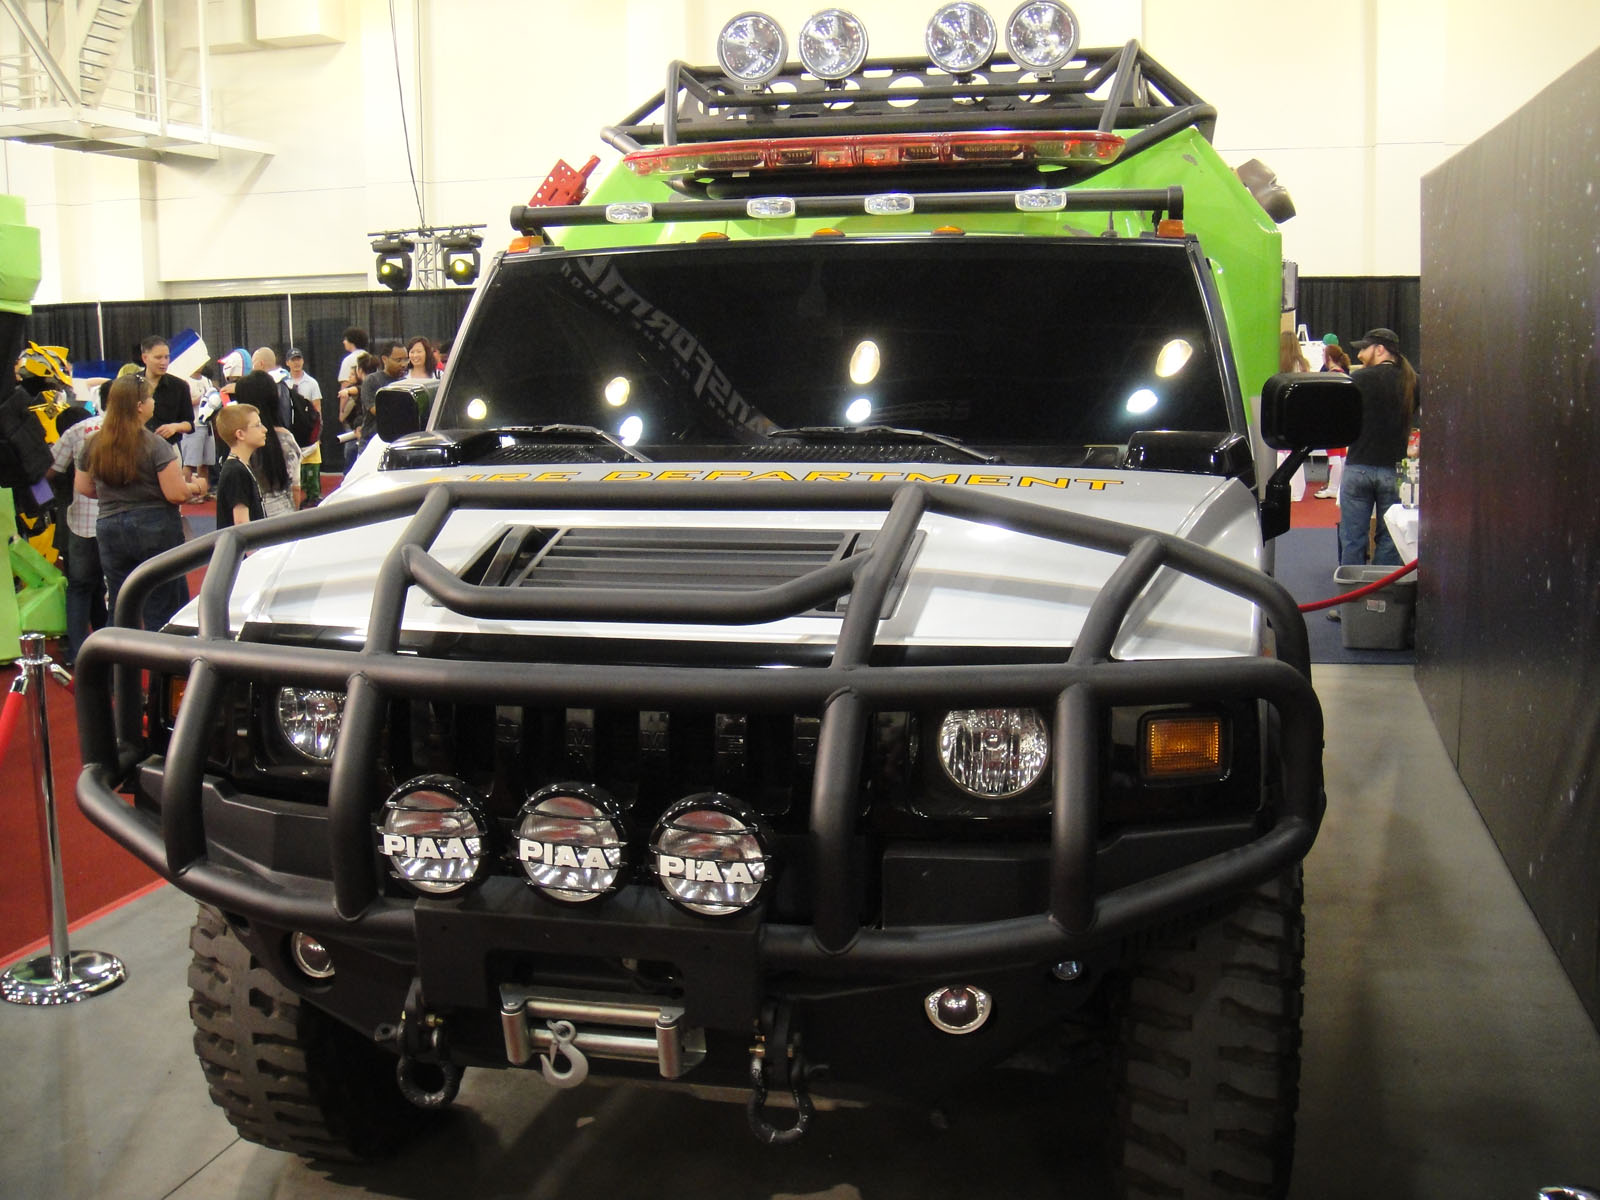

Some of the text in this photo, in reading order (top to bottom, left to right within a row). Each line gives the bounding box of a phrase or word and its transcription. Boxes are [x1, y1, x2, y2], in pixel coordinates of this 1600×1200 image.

[600, 470, 1124, 491] DEPARTMENT
[383, 833, 470, 860] PIAA
[519, 838, 610, 870] PIAA
[659, 854, 754, 885] PIAA
